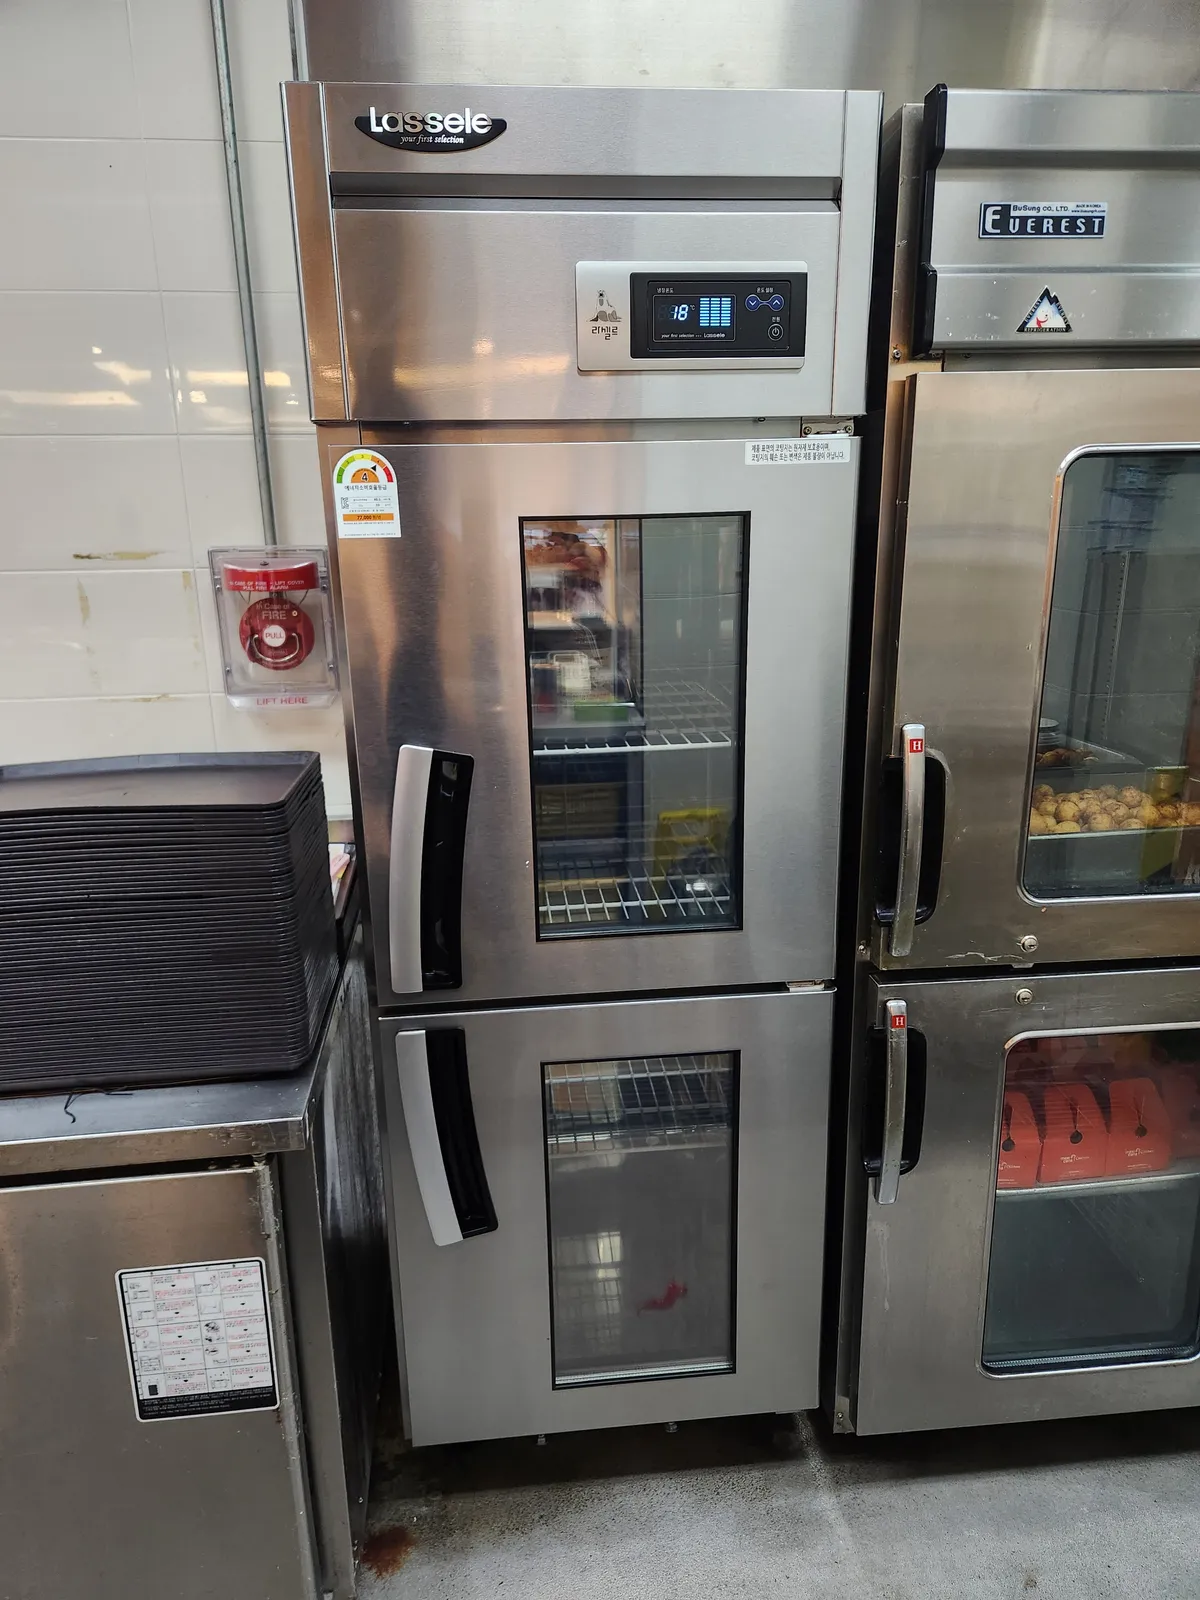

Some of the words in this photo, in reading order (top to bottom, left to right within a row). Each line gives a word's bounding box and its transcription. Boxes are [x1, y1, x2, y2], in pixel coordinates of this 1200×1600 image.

[369, 106, 492, 134] Lassele
[399, 136, 416, 145] your
[417, 134, 433, 145] first
[434, 135, 465, 144] selection
[1012, 204, 1041, 214] BuSung
[984, 205, 1103, 234] EVEREST
[673, 304, 689, 321] 18
[262, 610, 287, 620] FIRE
[265, 632, 284, 640] PULL
[256, 697, 276, 706] LIFT
[280, 696, 308, 705] HERE
